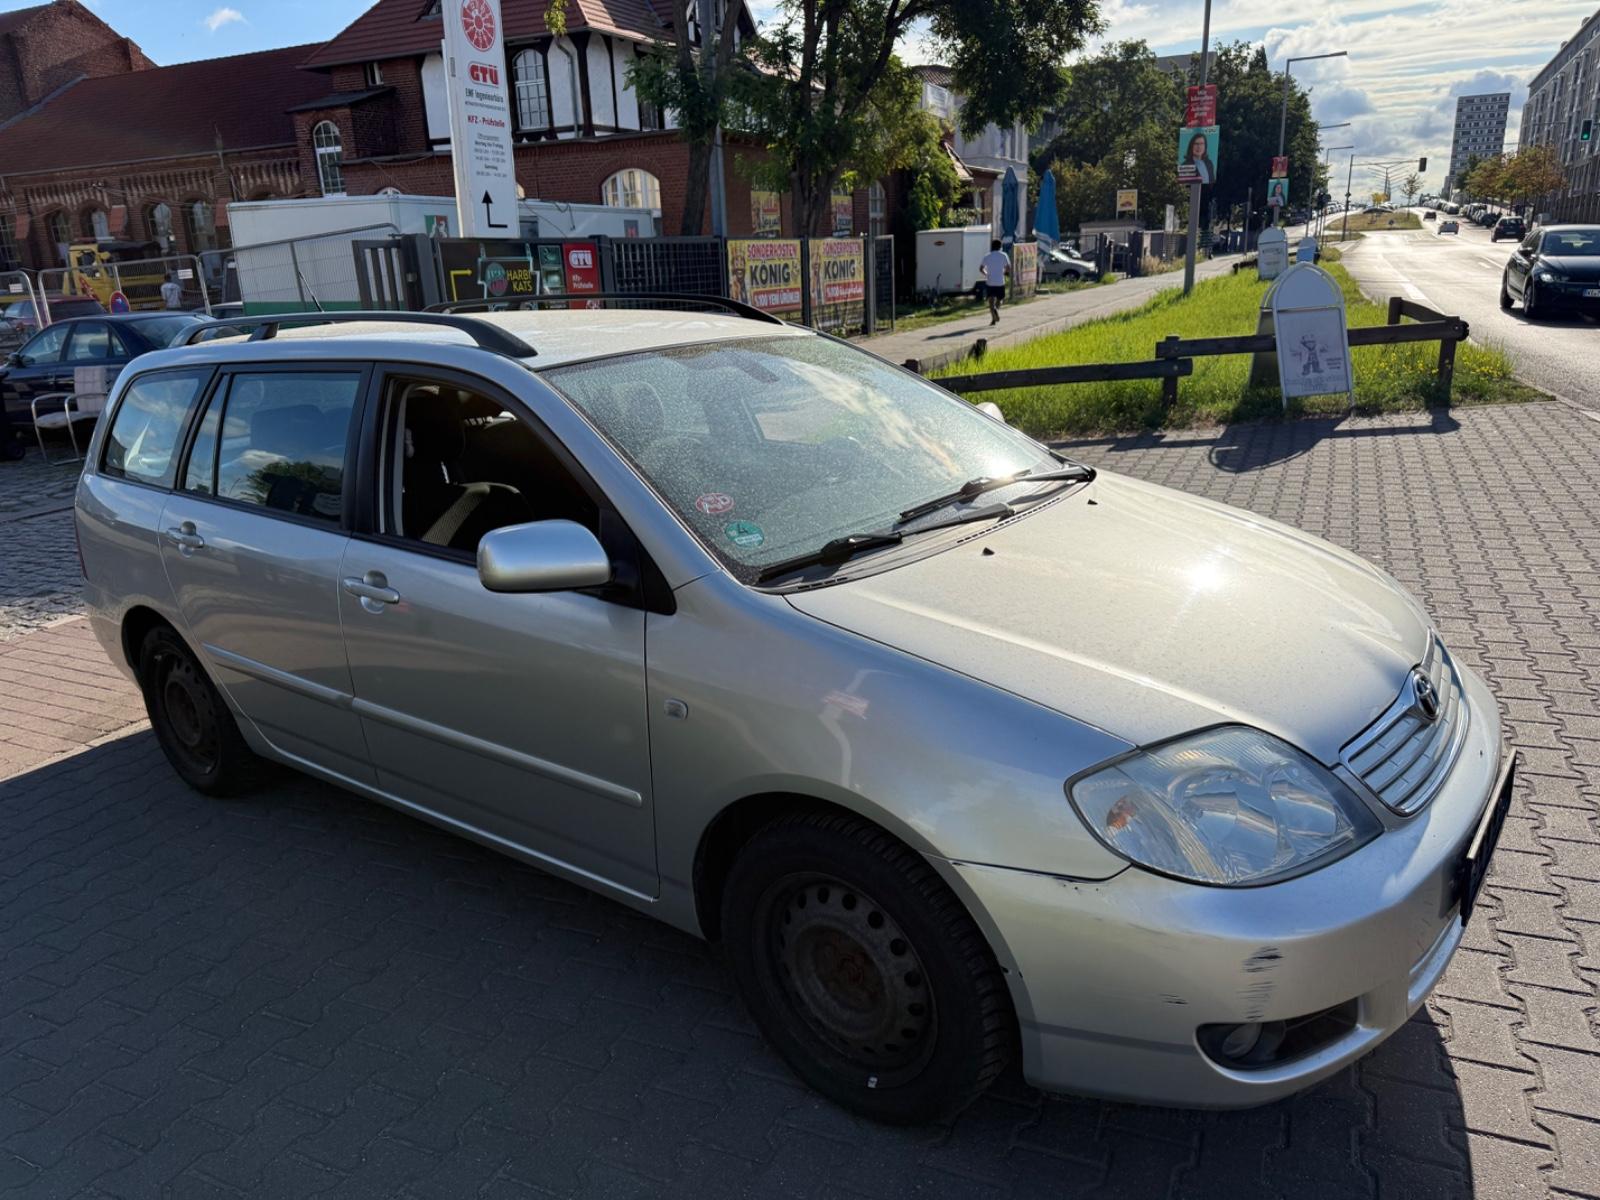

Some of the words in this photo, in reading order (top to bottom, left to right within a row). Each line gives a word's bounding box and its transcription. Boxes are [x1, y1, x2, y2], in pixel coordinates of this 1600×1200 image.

[470, 64, 499, 85] GTÜ
[507, 269, 532, 280] HARBI
[751, 261, 790, 286] KÖNIG
[512, 280, 533, 292] KATS
